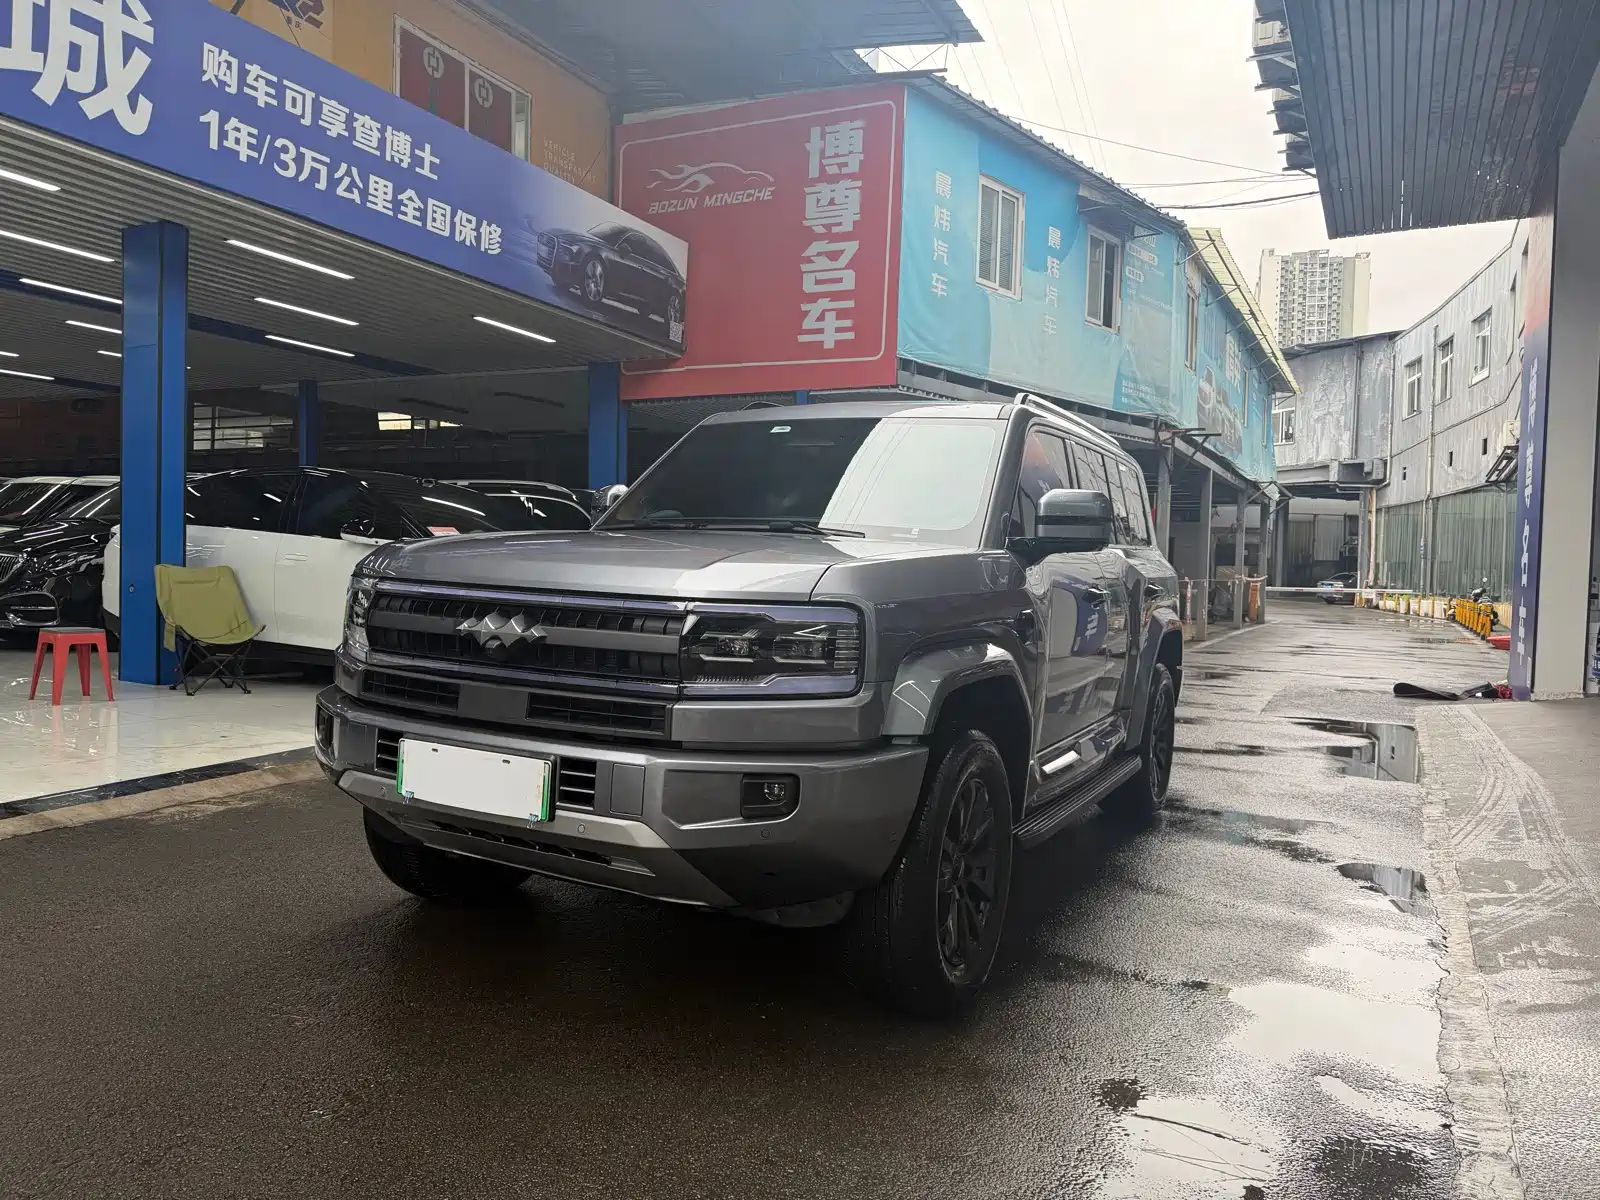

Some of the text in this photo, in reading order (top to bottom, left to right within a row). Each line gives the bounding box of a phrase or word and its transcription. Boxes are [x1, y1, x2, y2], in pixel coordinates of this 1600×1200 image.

[0, 0, 154, 135] 城
[202, 42, 441, 181] 购车可享查博士
[199, 109, 502, 256] 1年/3万公里全国保修
[543, 139, 576, 161] VEHICLE
[704, 187, 776, 208] MINGCHE
[797, 119, 866, 349] 博尊名车
